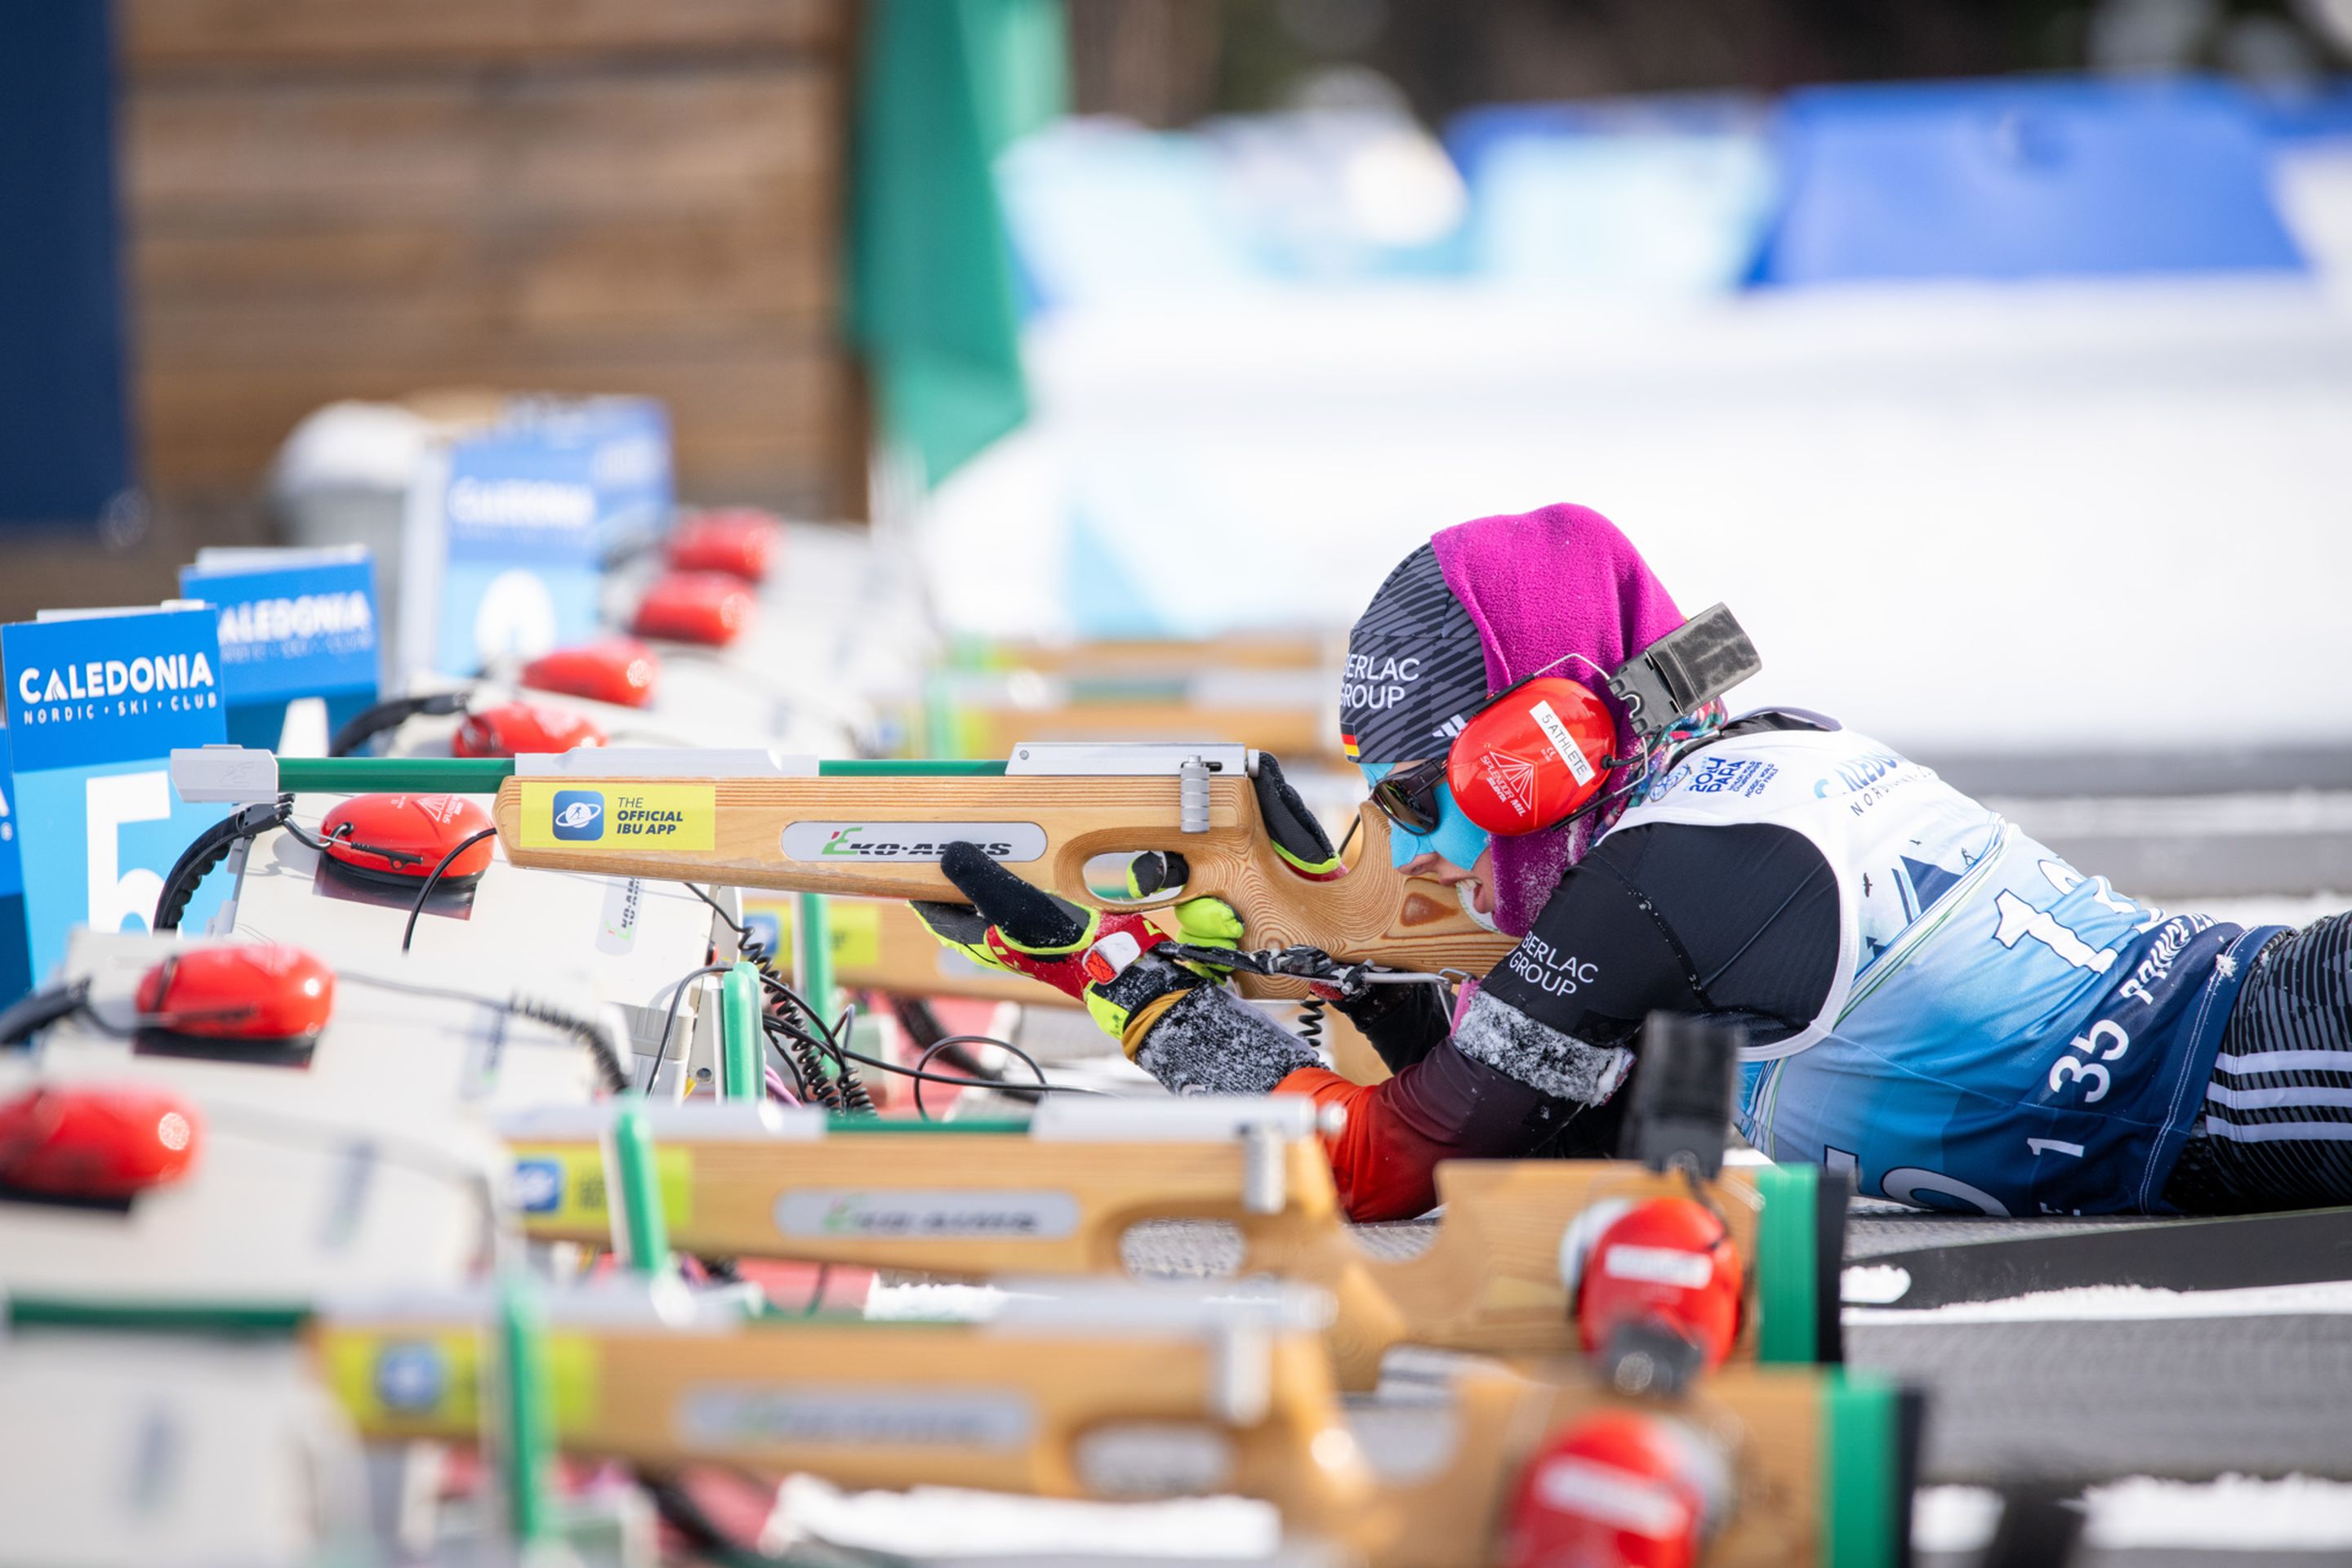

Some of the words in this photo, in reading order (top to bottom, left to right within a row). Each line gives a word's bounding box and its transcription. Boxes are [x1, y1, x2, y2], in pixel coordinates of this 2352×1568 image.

[218, 590, 371, 644] ALEDONIA
[19, 652, 214, 705] CALEDONIA
[1343, 653, 1420, 681] ERLAC
[24, 704, 95, 725] NORDIC
[118, 699, 148, 717] SKI
[170, 692, 217, 711] CLUB
[1542, 714, 1553, 724] 5
[1548, 724, 1588, 776] ATHLETE
[1480, 755, 1515, 800] SPLENDOR
[1510, 798, 1526, 817] MIL
[1706, 760, 1746, 792] PARA
[617, 796, 644, 808] THE
[617, 810, 684, 822] OFFICIAL
[616, 823, 643, 835] IBU
[645, 823, 677, 835] APP
[1509, 951, 1577, 996] GROUP
[1521, 930, 1599, 983] BERLAC
